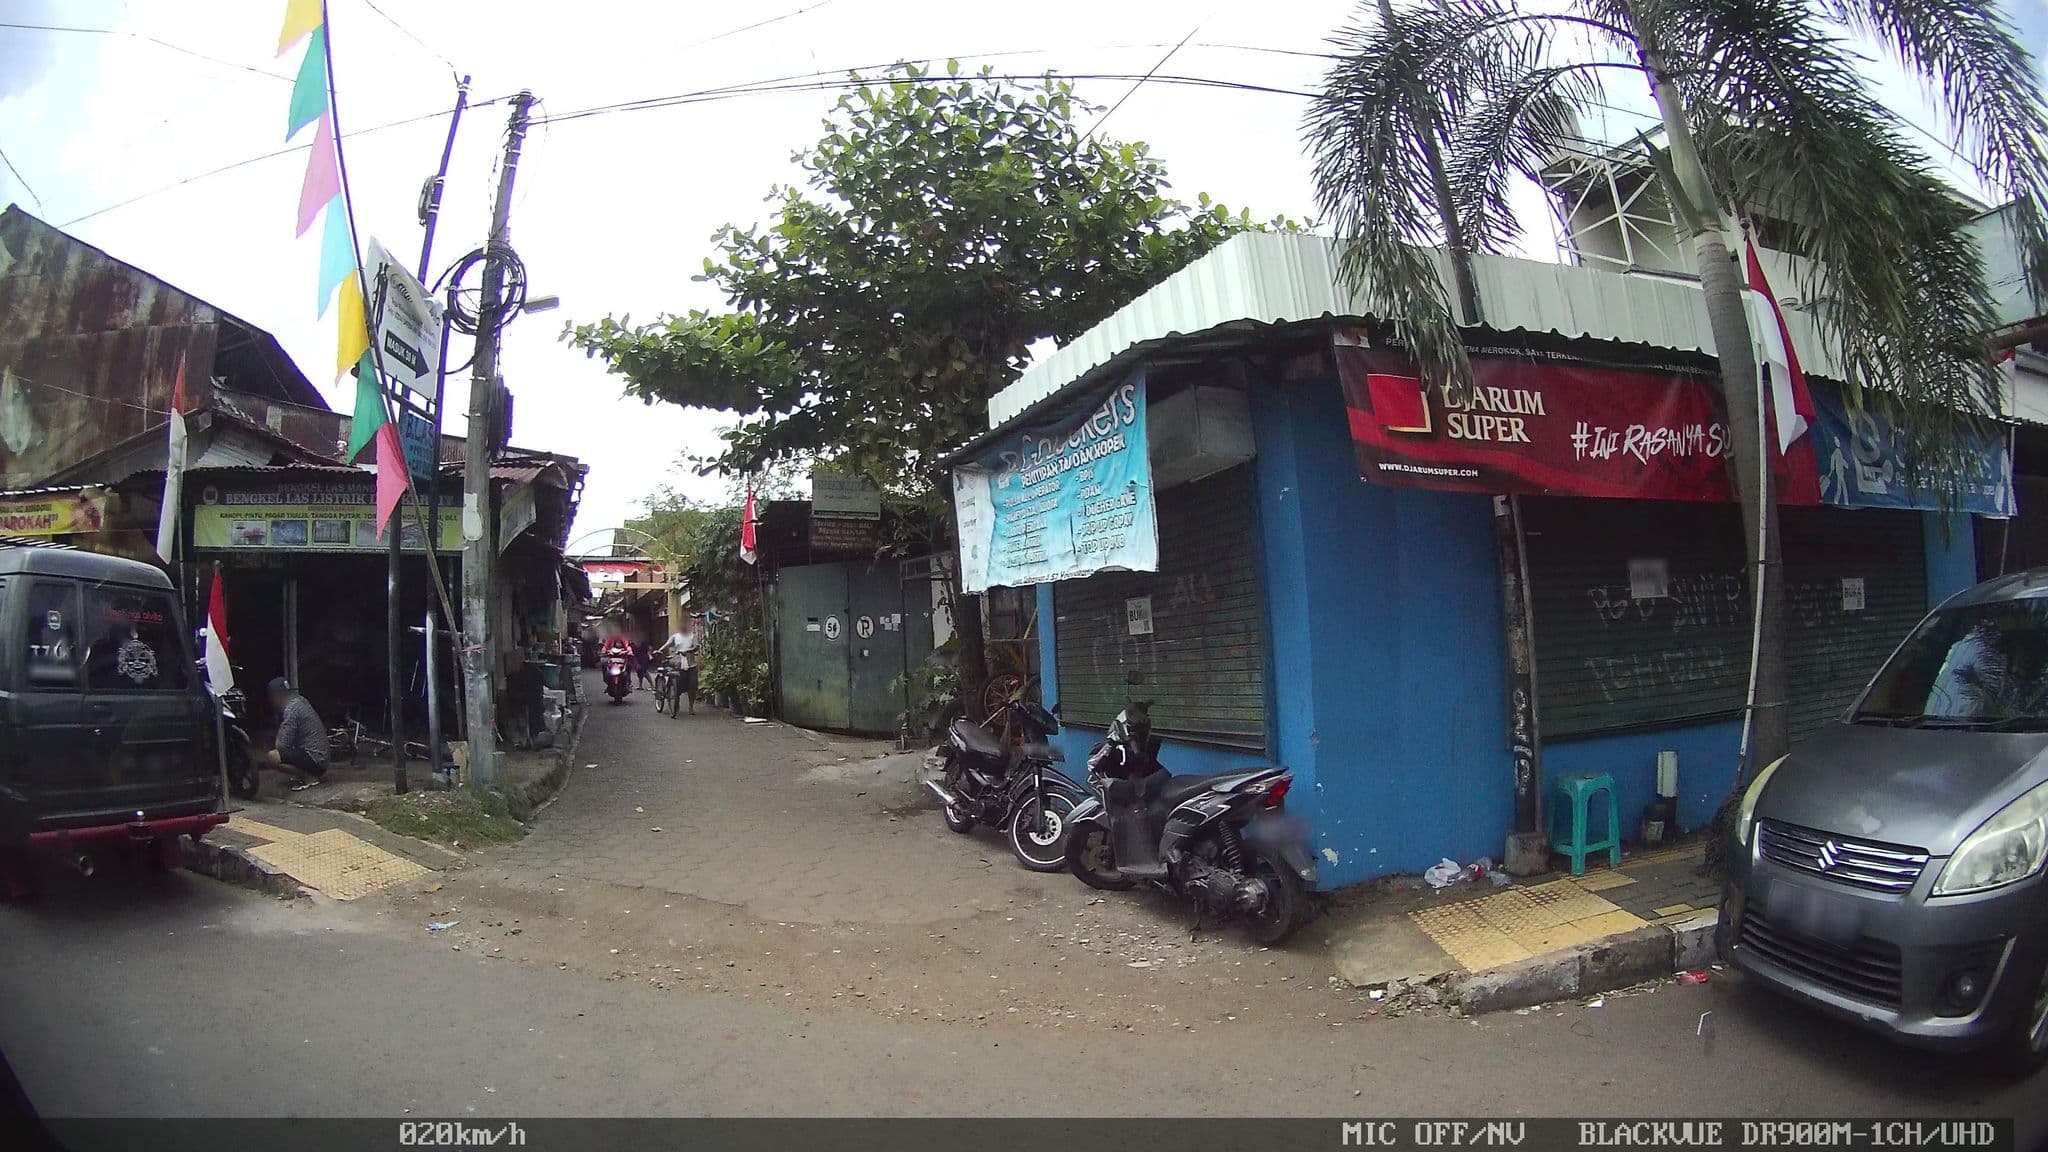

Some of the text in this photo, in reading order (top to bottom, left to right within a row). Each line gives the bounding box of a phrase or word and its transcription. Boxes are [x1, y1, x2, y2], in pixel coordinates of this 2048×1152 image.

[1440, 385, 1546, 416] DJARUM
[1447, 413, 1532, 443] SUPER
[1621, 422, 1705, 466] RASANYA
[1378, 462, 1479, 478] WWW.DJARUMSUPER.COM
[226, 493, 283, 505] BENGKEL
[286, 493, 309, 504] LAS
[312, 493, 367, 505] LISTRIK
